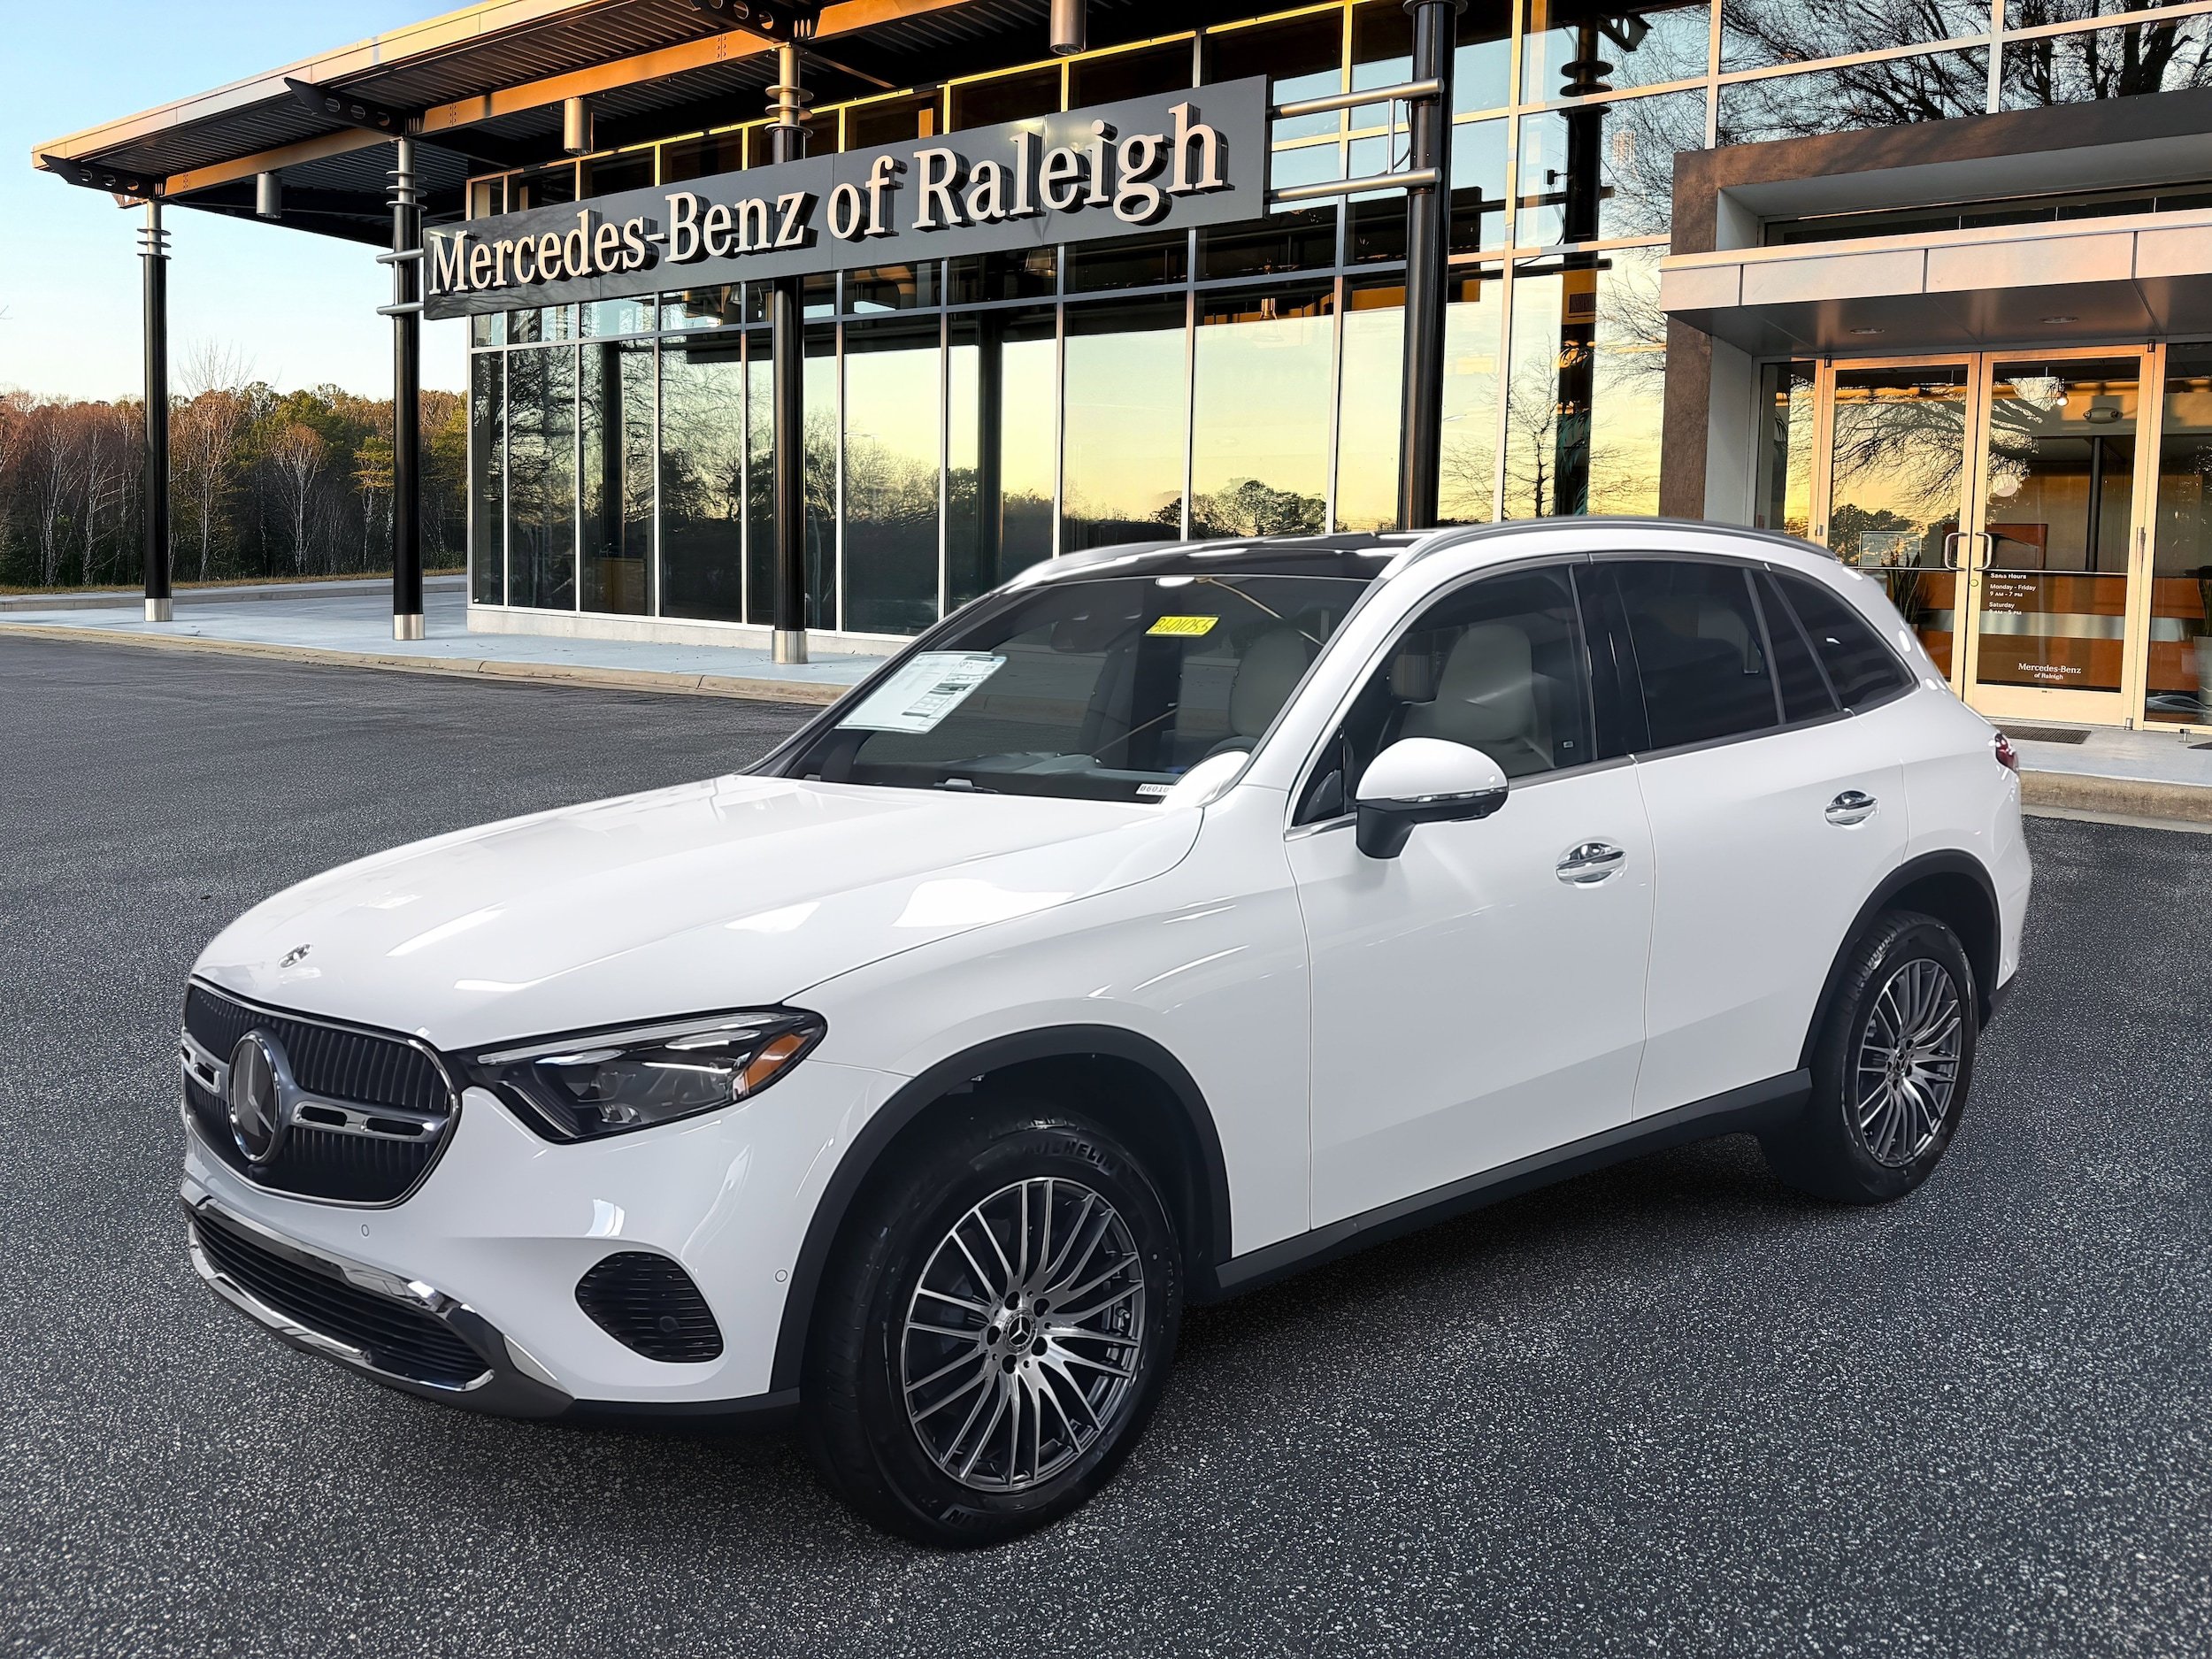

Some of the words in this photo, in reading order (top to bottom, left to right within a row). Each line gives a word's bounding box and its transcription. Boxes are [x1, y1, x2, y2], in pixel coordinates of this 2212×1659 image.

[428, 190, 810, 296] Mercedes-Benz
[827, 154, 901, 240] of
[911, 102, 1225, 230] Raleigh
[2017, 662, 2082, 674] Mercedes-Benz
